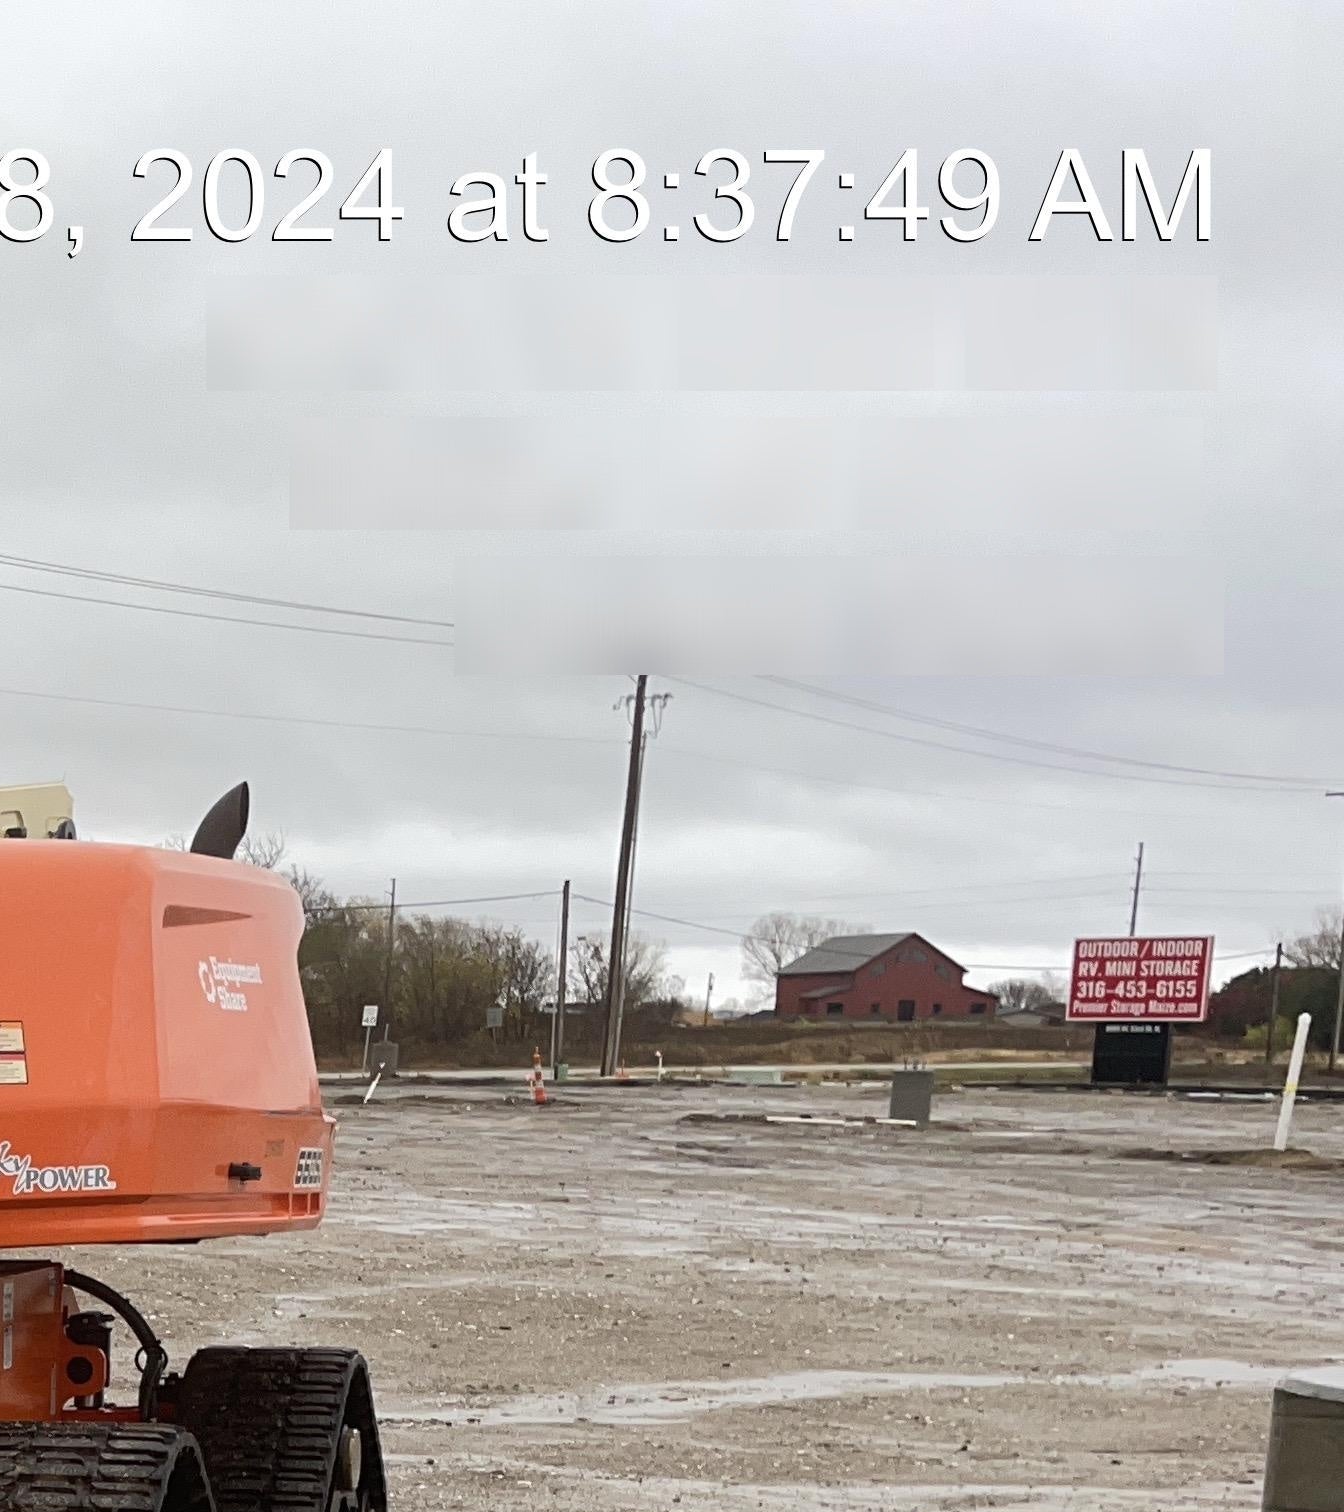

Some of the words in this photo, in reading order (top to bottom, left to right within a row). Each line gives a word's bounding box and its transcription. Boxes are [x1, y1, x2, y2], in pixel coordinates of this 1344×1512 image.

[1078, 941, 1139, 958] OUTDOOR
[1152, 940, 1204, 957] INDOOR
[1105, 961, 1136, 977] MINI
[1140, 960, 1200, 977] STORAGE
[1076, 980, 1197, 998] 316-453-6155
